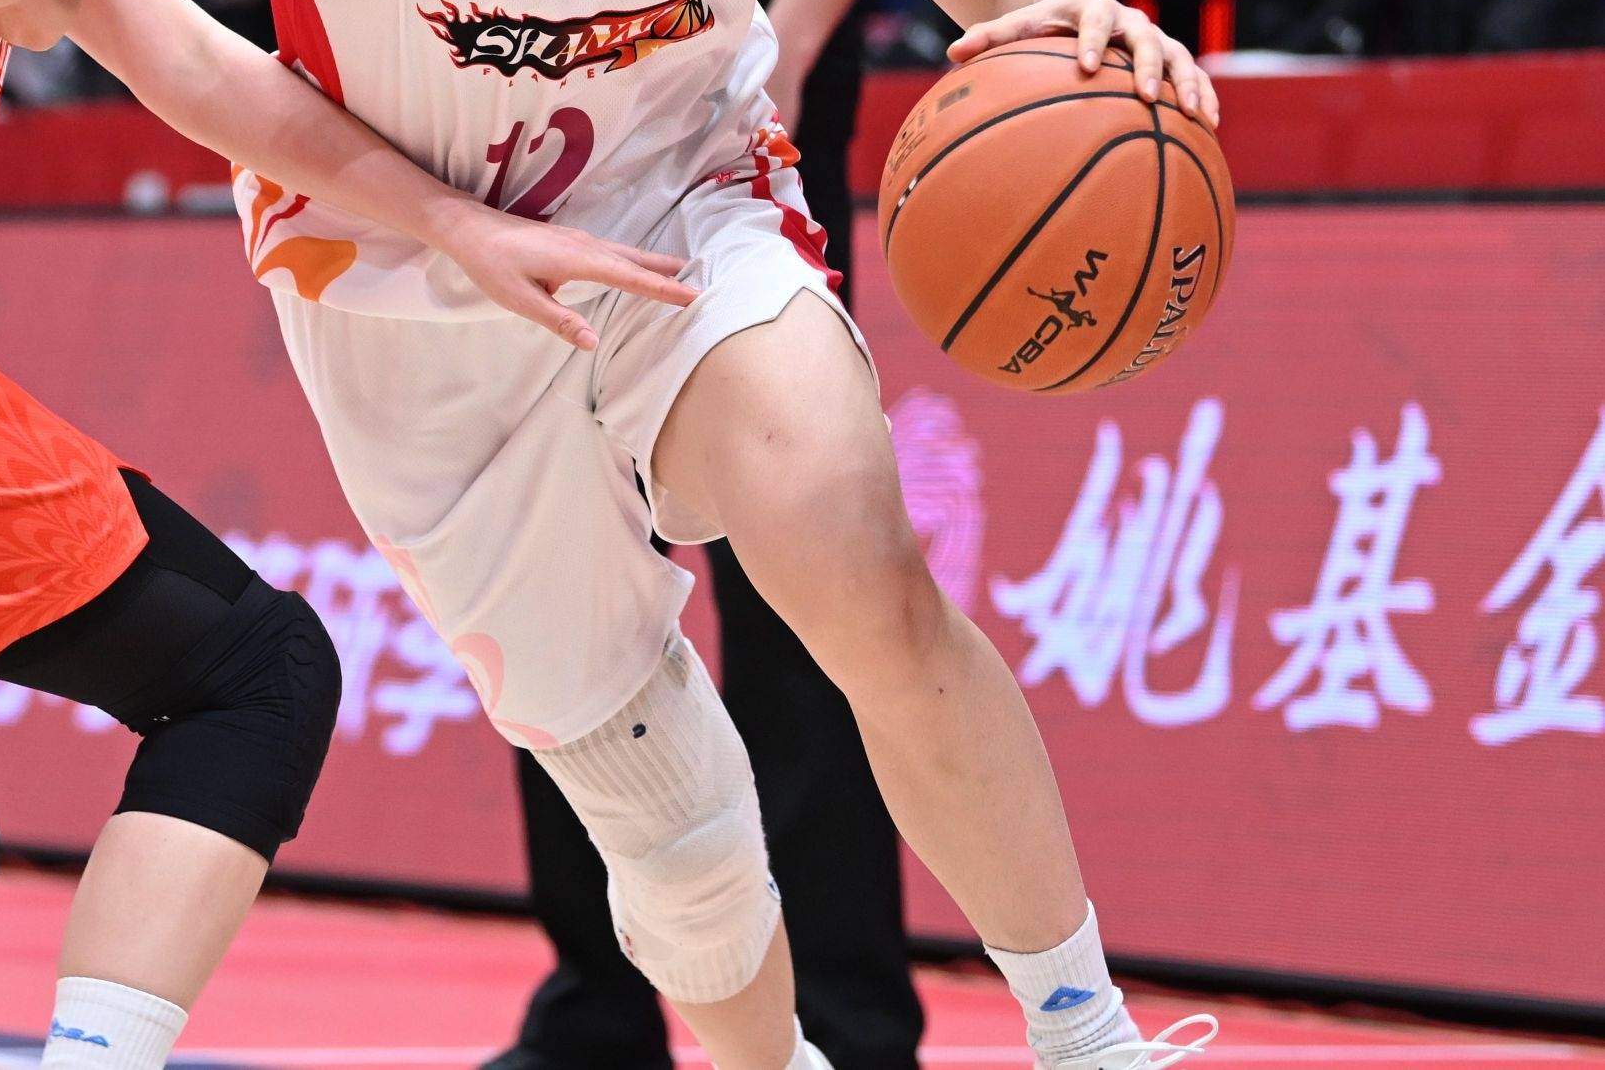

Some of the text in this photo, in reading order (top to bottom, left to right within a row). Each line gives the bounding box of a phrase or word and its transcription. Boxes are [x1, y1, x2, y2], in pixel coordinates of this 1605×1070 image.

[484, 106, 595, 223] 12
[991, 397, 1605, 746] 姚基金
